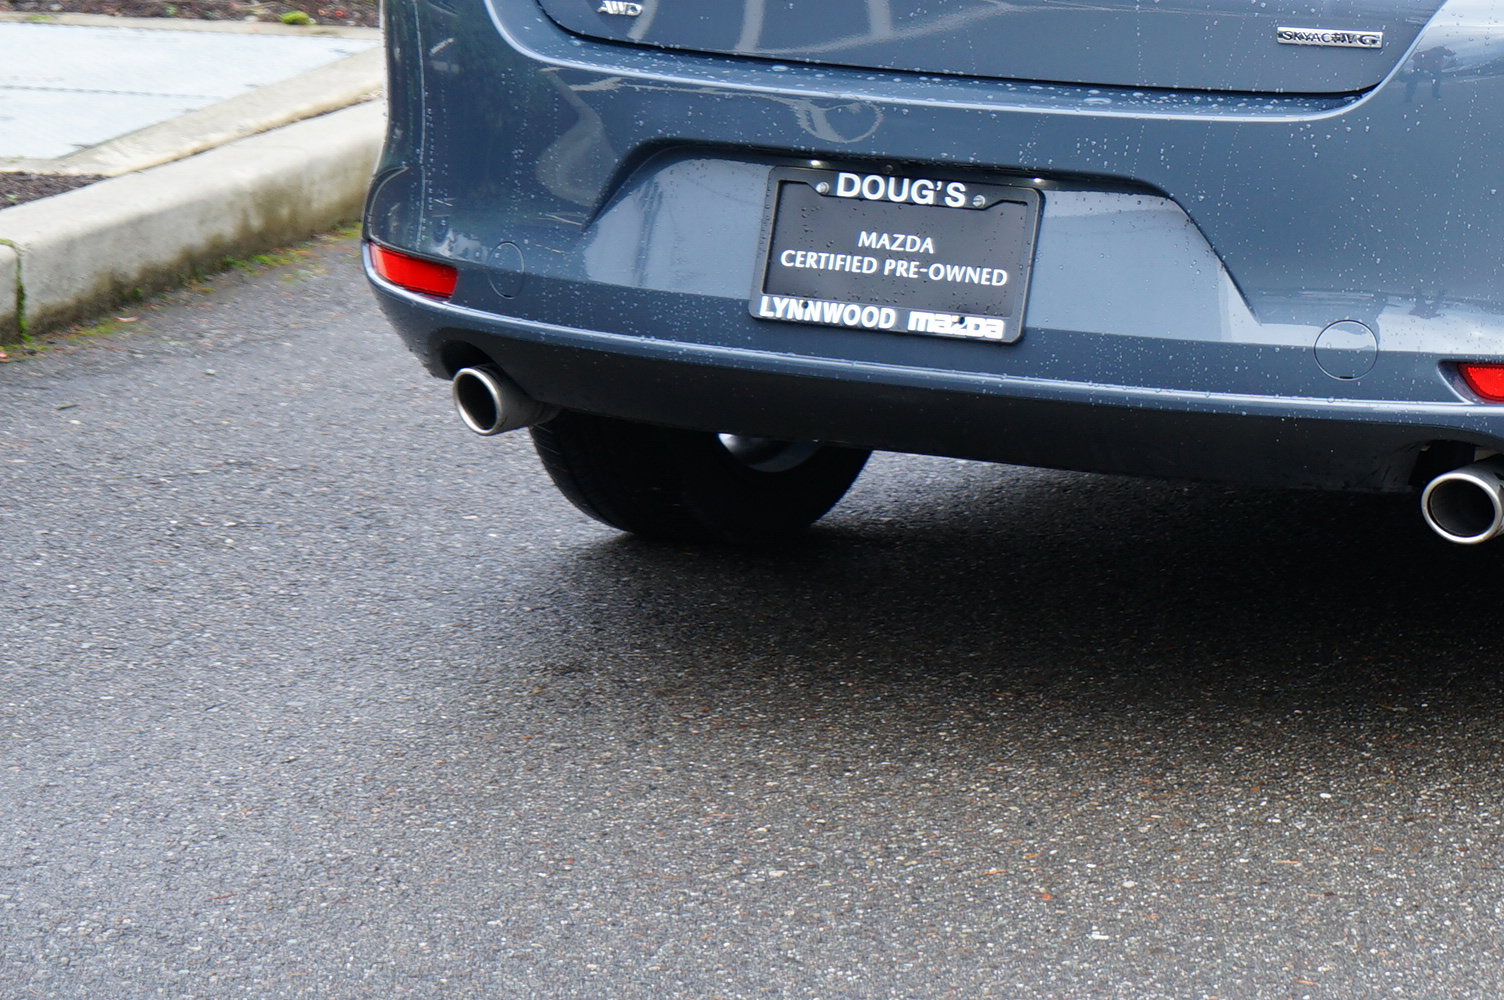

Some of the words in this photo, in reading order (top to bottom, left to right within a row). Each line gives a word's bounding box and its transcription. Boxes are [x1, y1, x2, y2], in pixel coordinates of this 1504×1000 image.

[597, 0, 643, 17] AWD
[1278, 30, 1357, 44] SKYACTIV
[836, 172, 967, 208] DOUG'S
[857, 230, 935, 254] MAZDA
[780, 250, 878, 275] CERTIFIED
[883, 259, 1008, 287] PRE-OWNED
[759, 296, 897, 329] LYNNWOOD
